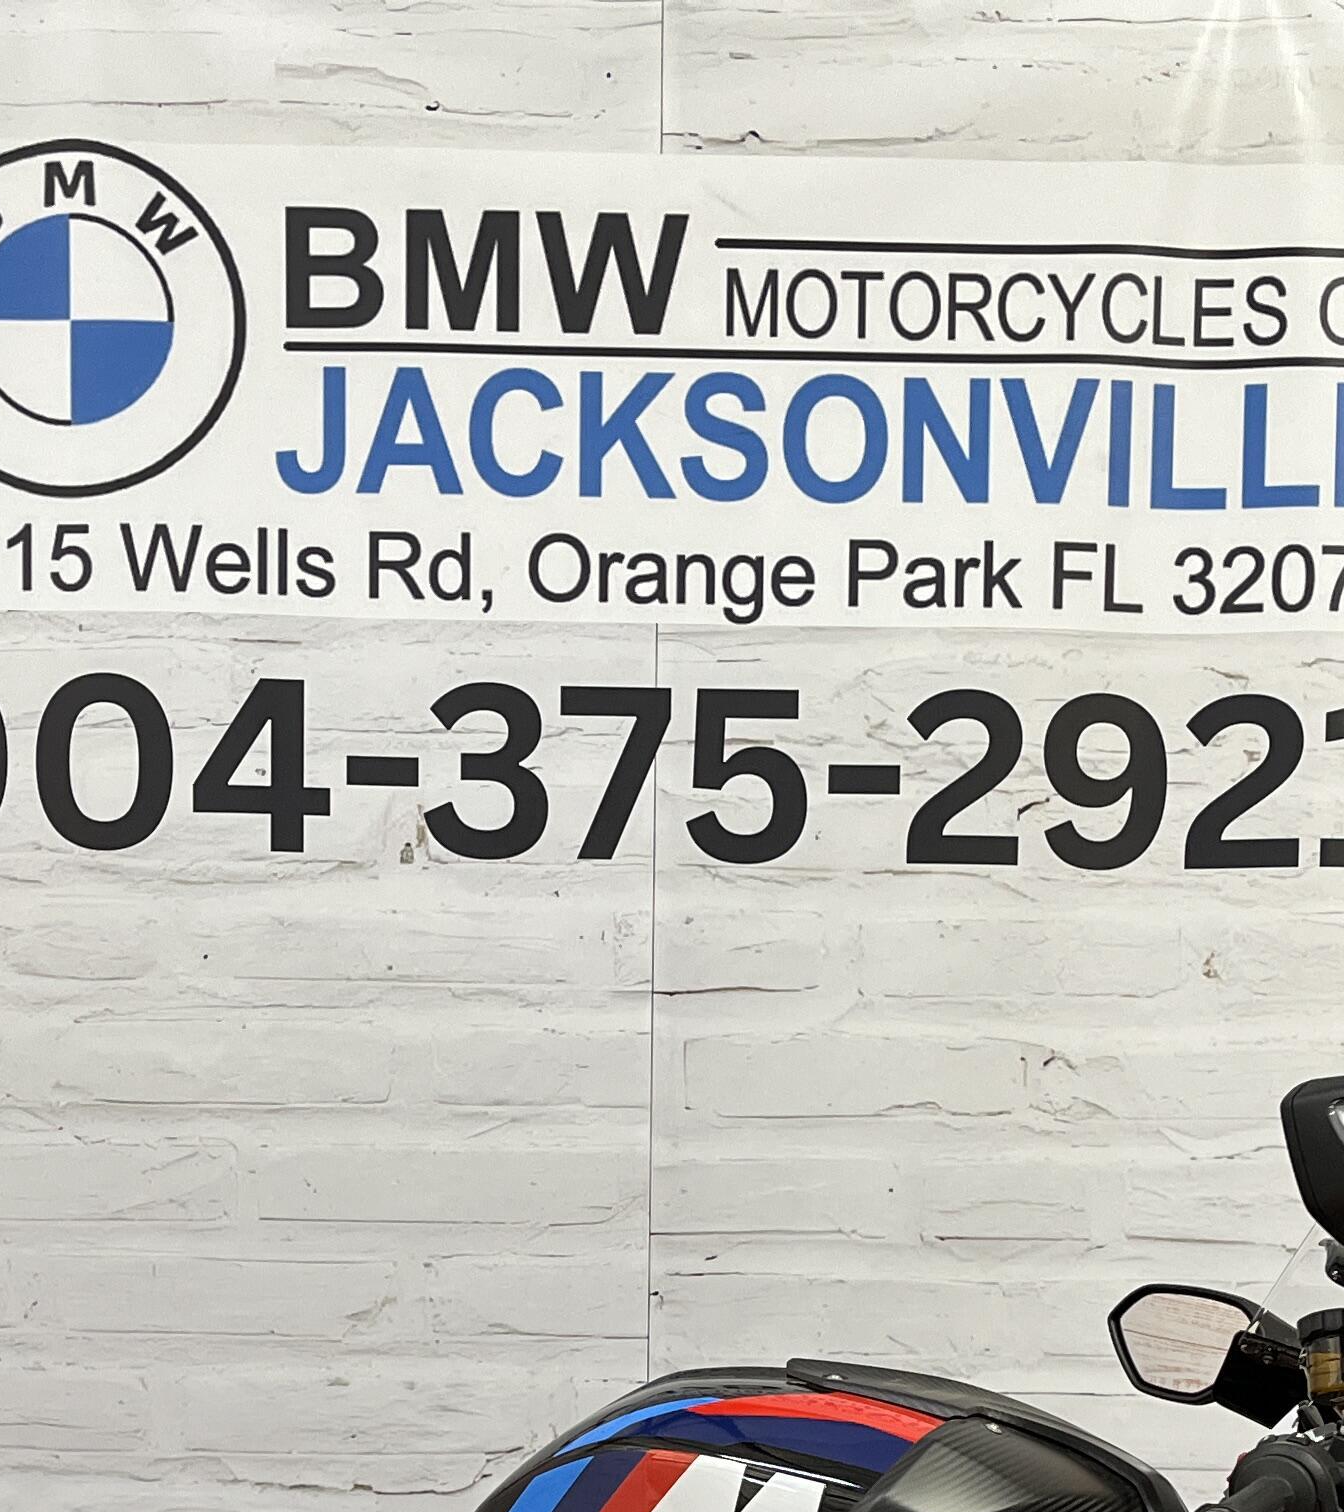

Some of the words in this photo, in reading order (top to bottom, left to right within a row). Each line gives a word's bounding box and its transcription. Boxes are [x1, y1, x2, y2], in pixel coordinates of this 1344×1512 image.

[284, 206, 689, 335] BMW
[725, 267, 1288, 348] MOTORCYCLES
[120, 523, 336, 599] Wells
[368, 530, 494, 613] Rd,
[528, 532, 815, 624] Orange
[847, 539, 1022, 611] Park
[1052, 541, 1143, 614] FL
